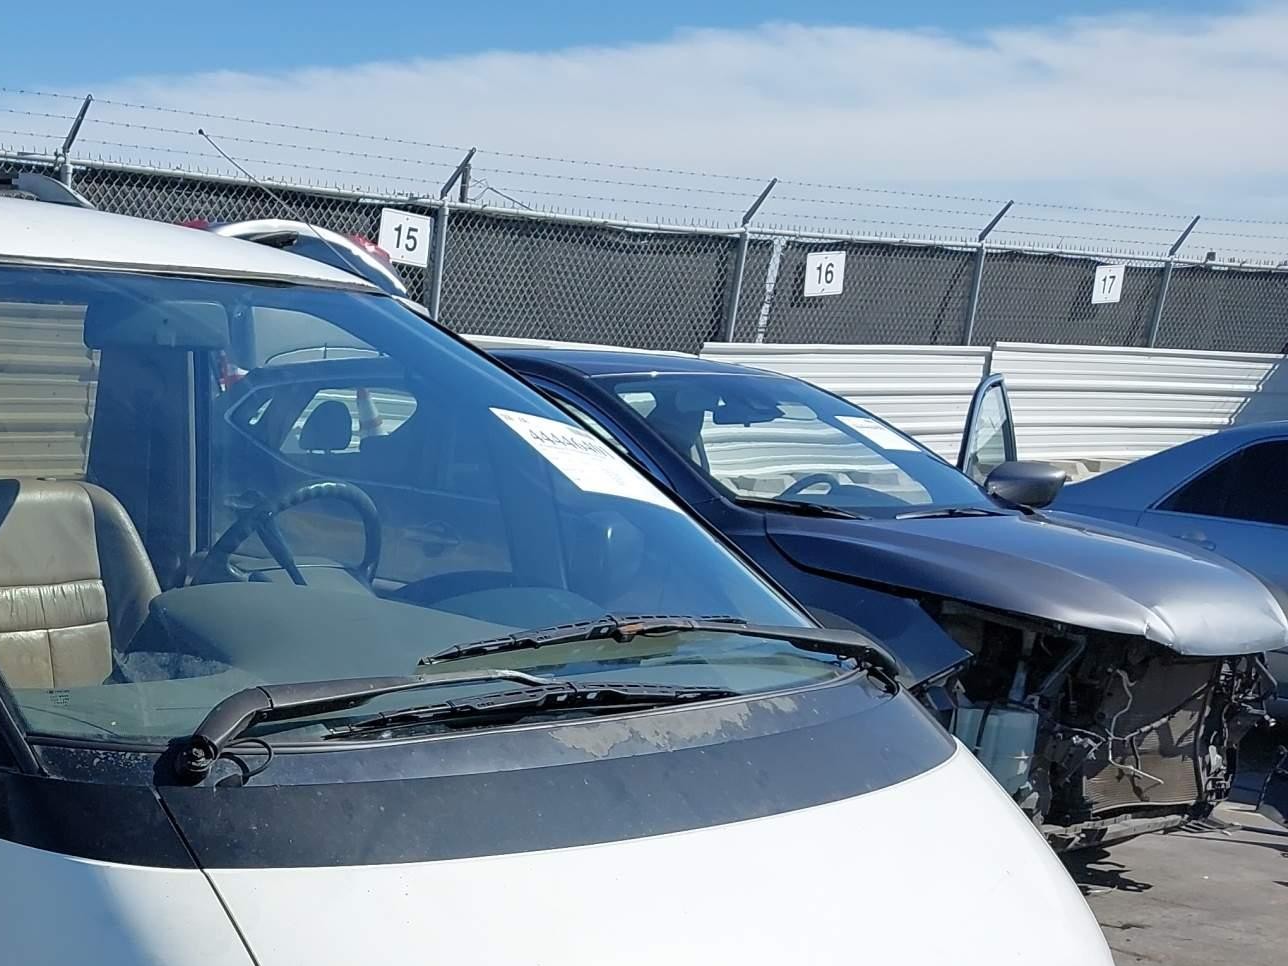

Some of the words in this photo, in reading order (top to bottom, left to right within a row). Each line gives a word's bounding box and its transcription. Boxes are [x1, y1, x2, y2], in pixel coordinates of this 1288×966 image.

[394, 223, 418, 252] 15
[816, 262, 834, 284] 16
[1102, 275, 1116, 294] 17
